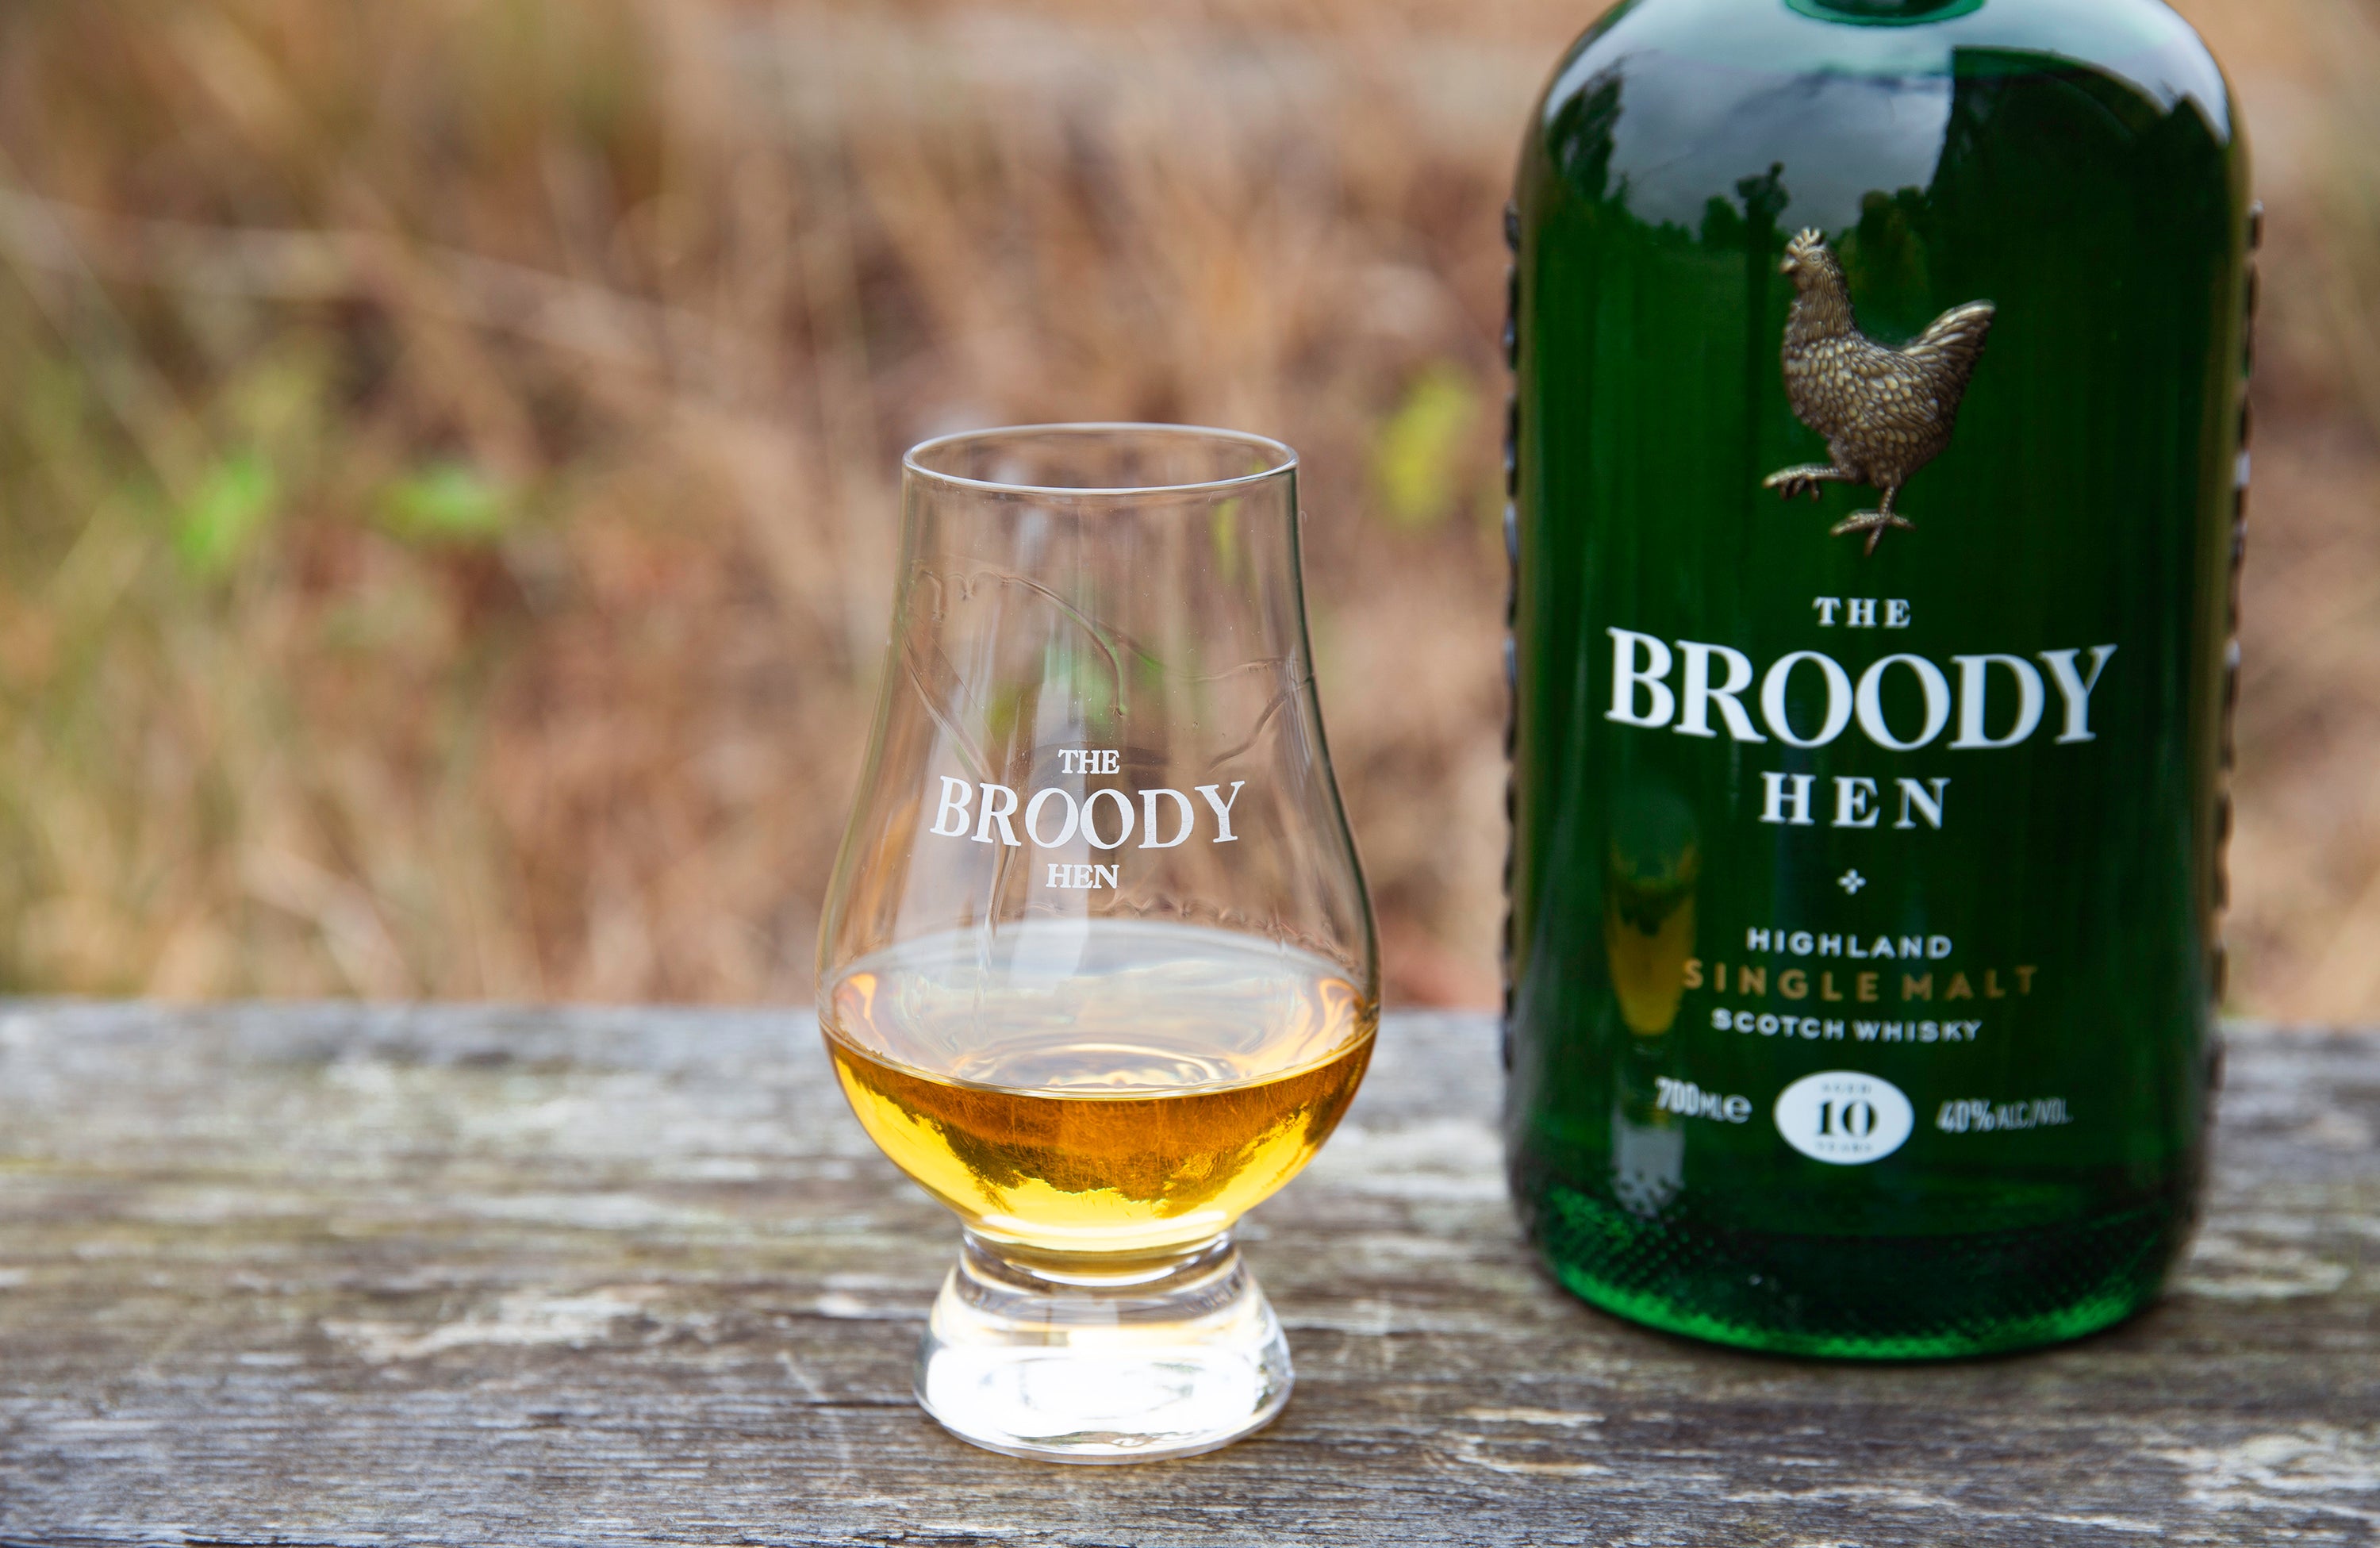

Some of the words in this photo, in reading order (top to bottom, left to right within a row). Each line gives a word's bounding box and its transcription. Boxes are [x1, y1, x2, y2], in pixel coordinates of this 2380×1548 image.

[1813, 597, 1911, 628] THE
[1604, 626, 2117, 751] BROODY
[1058, 749, 1120, 774] THE
[930, 775, 1246, 850] BROODY
[1758, 771, 1951, 829] HEN
[1046, 863, 1119, 889] HEN
[1745, 927, 1952, 960] HIGHLAND
[1683, 957, 1880, 1002] SINGLE
[1902, 965, 2038, 1001] MALT
[1710, 1008, 1844, 1041] SCOTCH
[1852, 1019, 1983, 1043] WHISKY
[1816, 1101, 1878, 1137] 10
